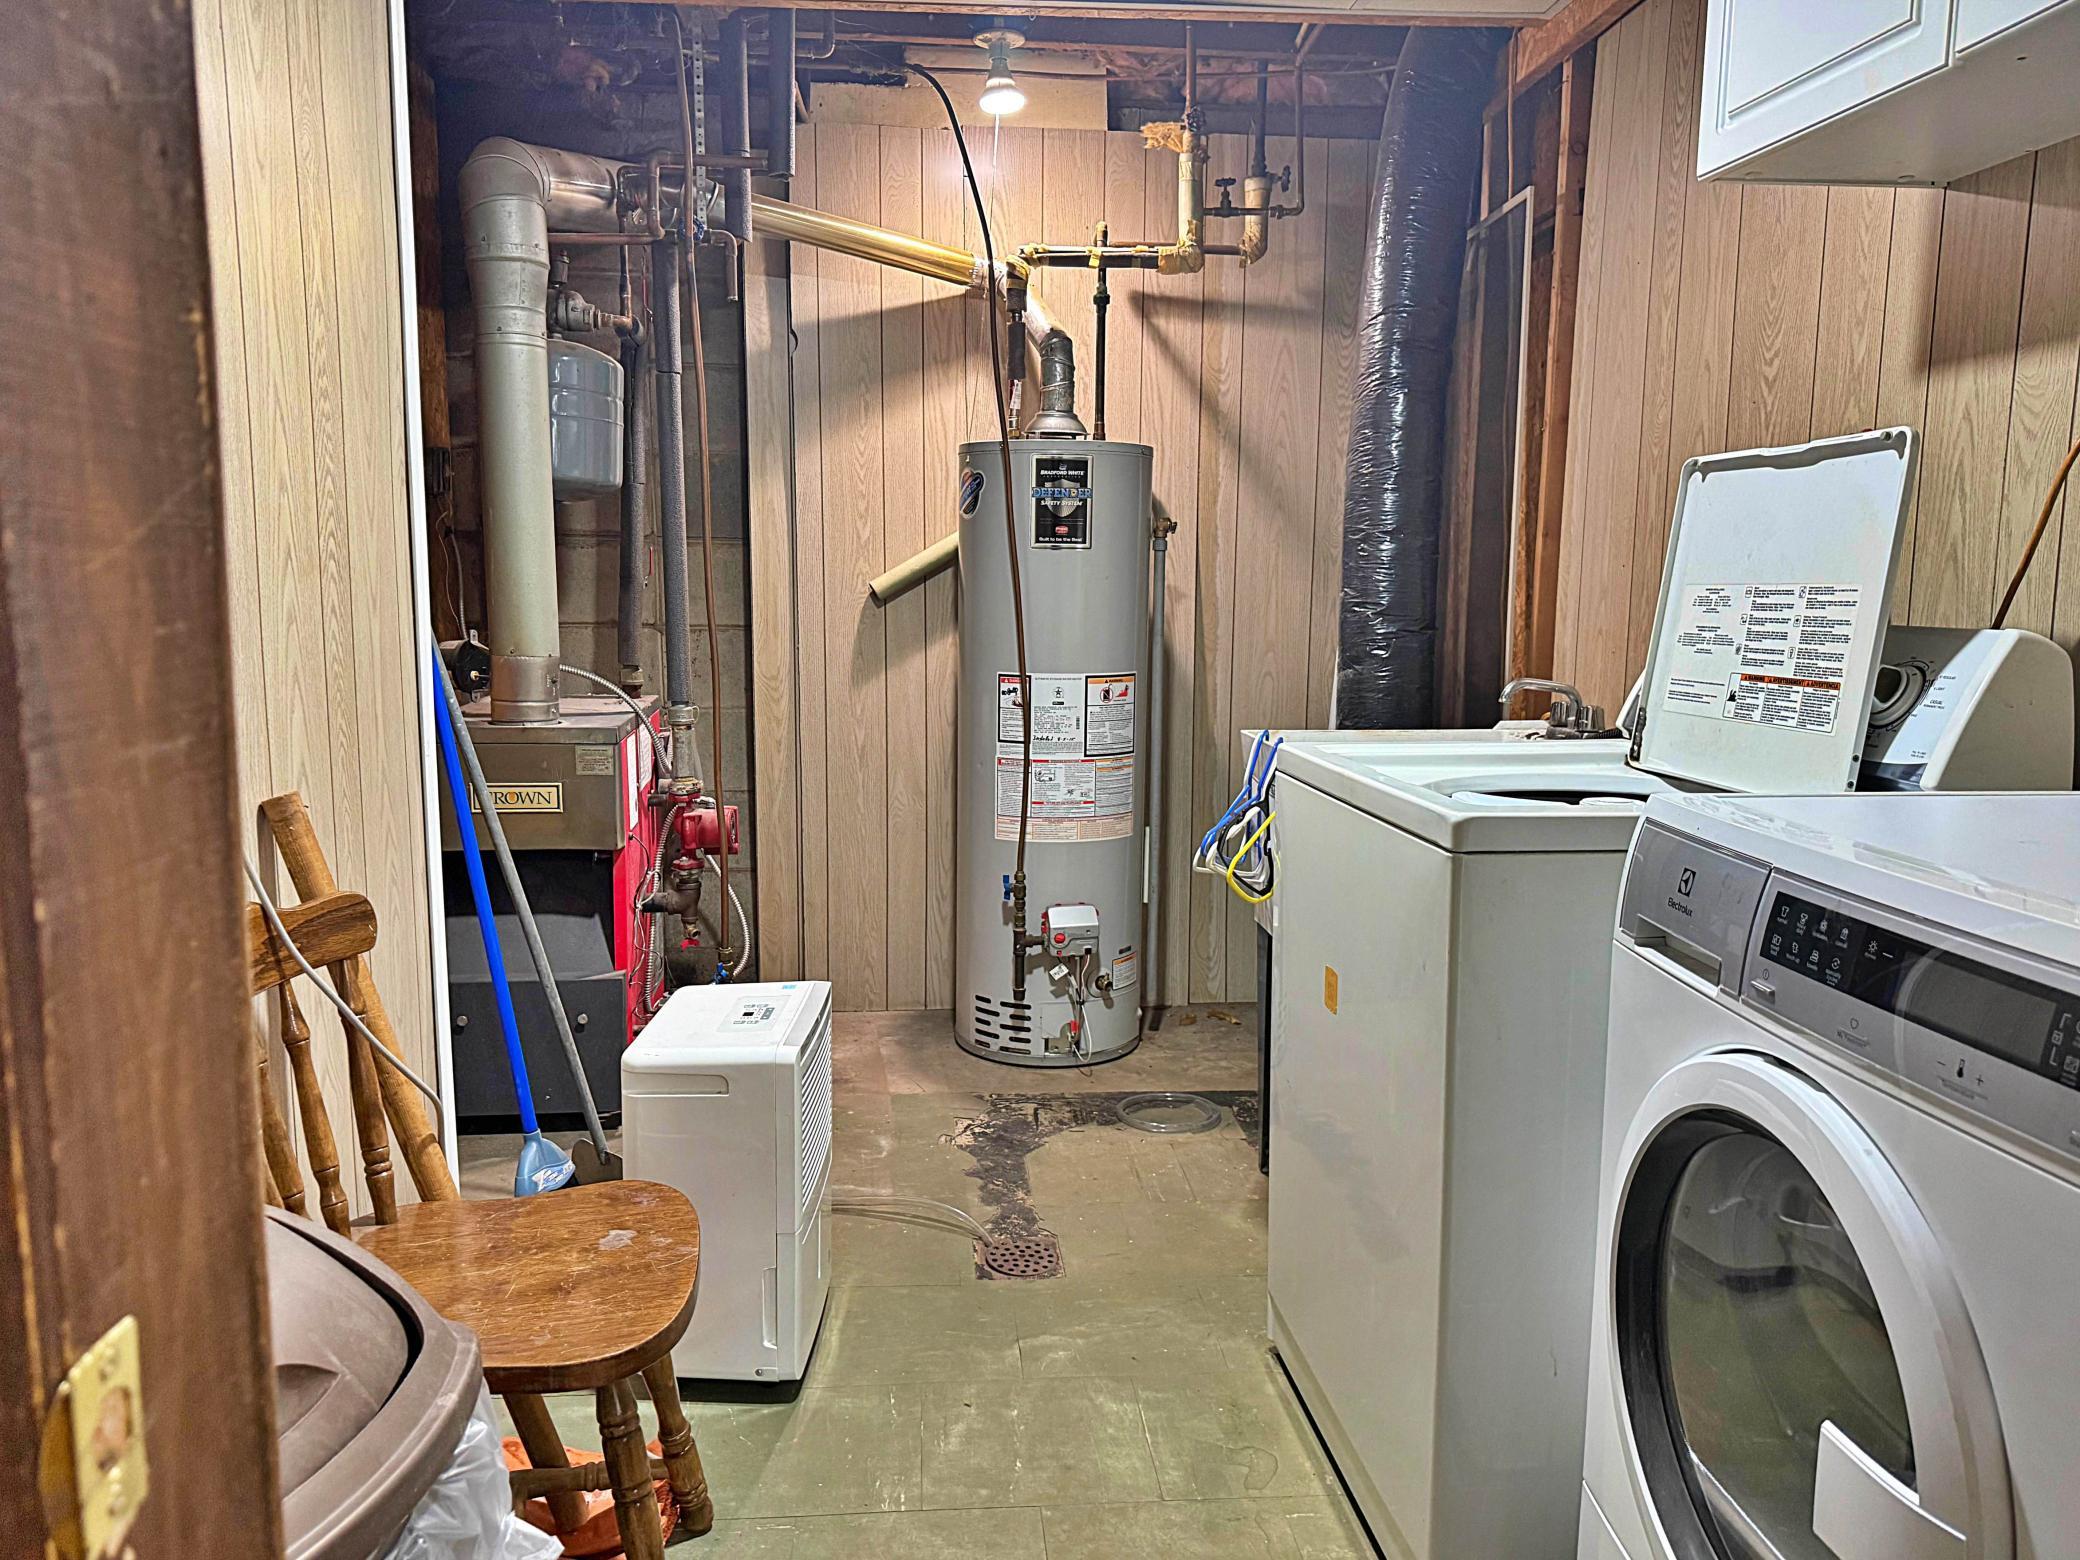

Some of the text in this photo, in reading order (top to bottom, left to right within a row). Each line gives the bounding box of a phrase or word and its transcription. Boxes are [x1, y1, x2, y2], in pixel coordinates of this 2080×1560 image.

[1033, 488, 1092, 498] DEFENDER
[490, 791, 552, 805] ROWN
[1667, 897, 1693, 917] Electrolux
